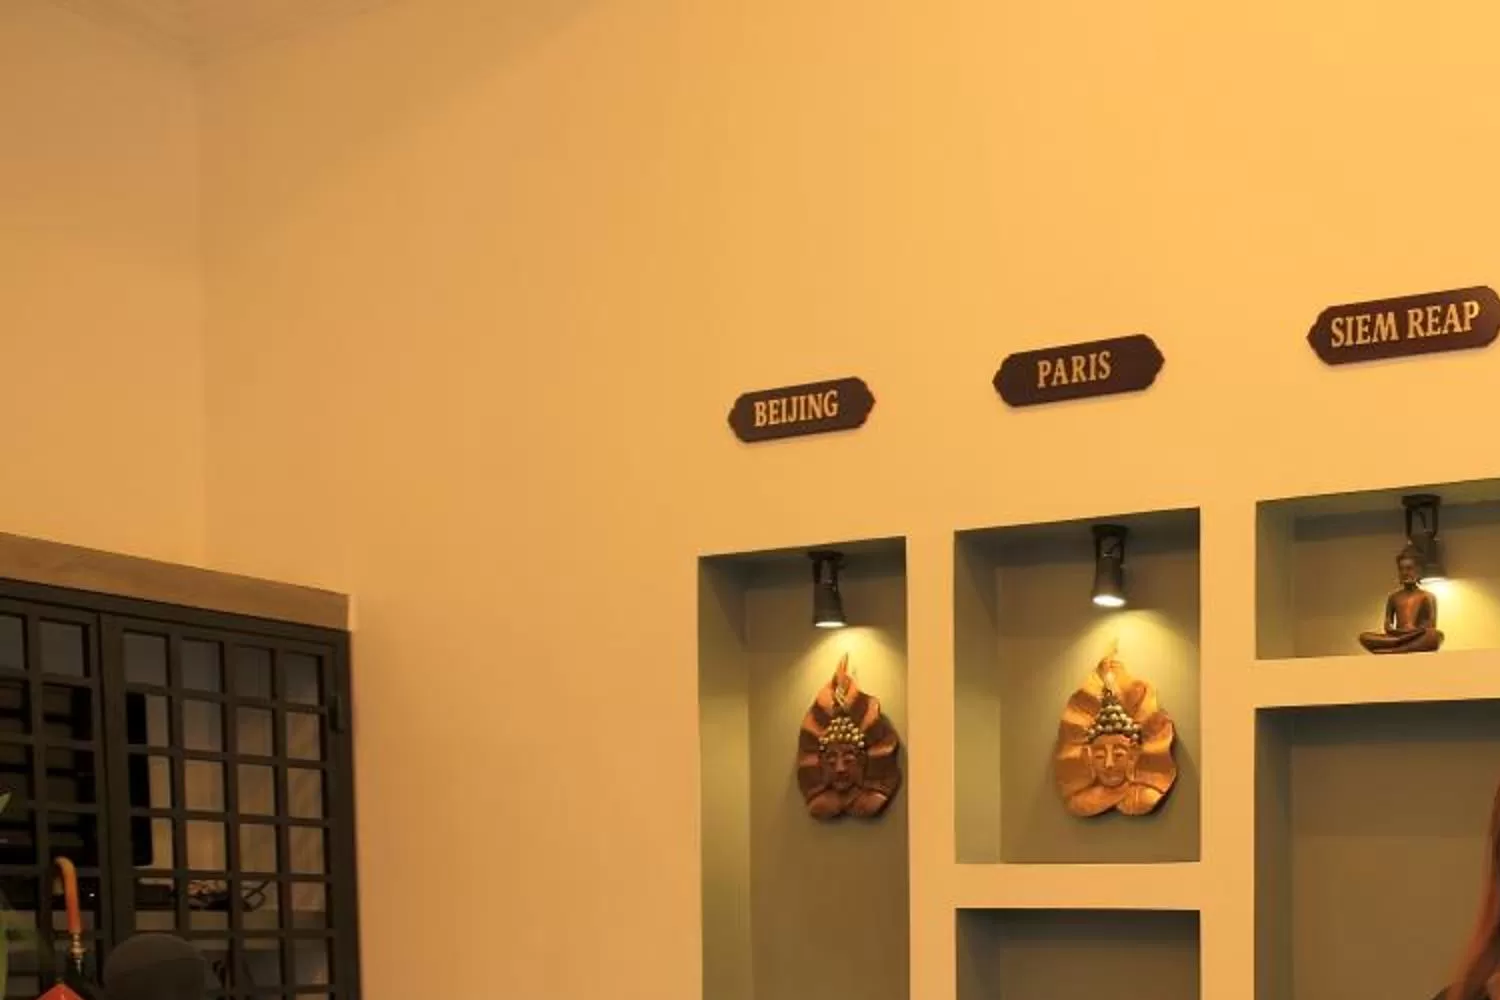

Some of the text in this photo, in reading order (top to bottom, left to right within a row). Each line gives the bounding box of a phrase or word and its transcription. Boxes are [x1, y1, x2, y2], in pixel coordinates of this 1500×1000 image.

[1330, 300, 1480, 347] SIEM REAP
[1036, 350, 1112, 389] PARIS
[753, 389, 839, 427] BEIJING
